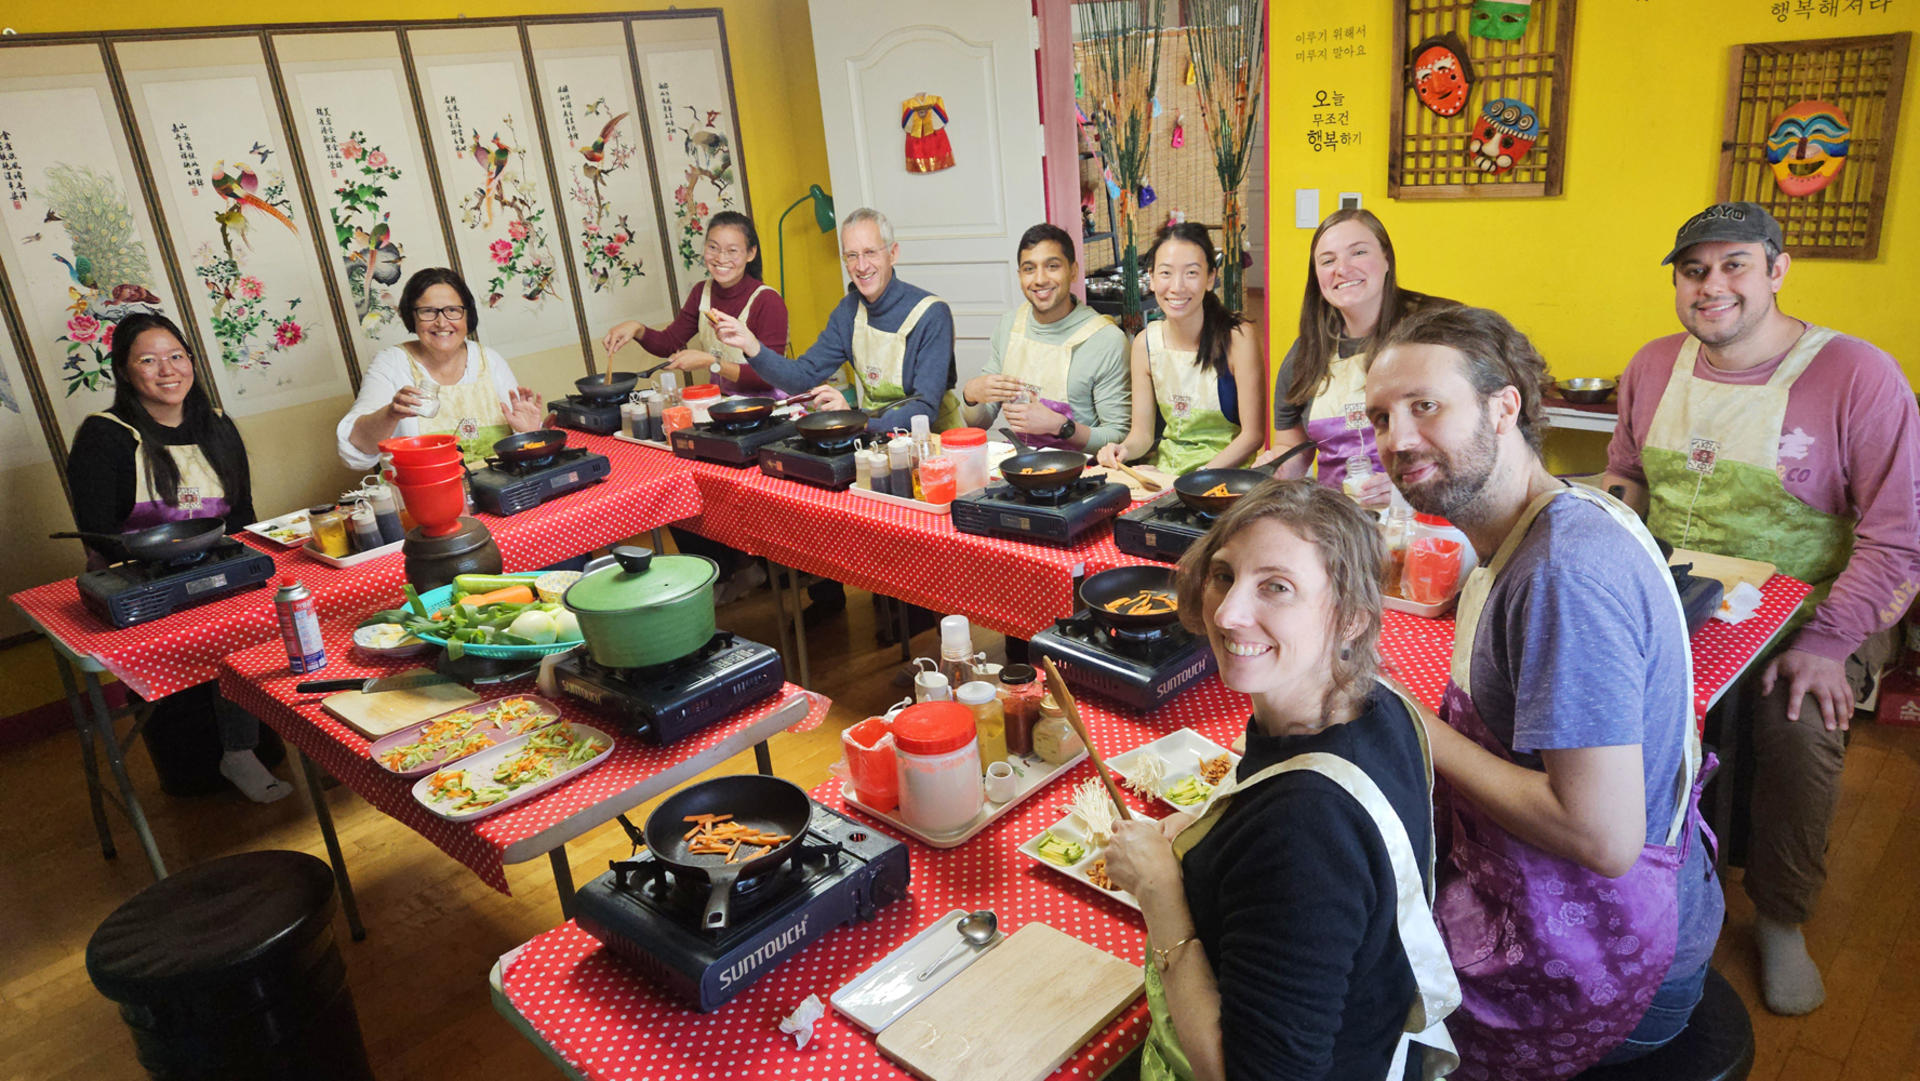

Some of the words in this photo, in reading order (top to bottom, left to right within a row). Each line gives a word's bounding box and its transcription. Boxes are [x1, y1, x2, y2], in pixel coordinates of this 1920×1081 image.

[1295, 29, 1327, 44] 이루기
[1333, 24, 1366, 40] 위해서
[1333, 44, 1367, 59] 말아요
[1312, 90, 1345, 108] 오늘
[1312, 110, 1349, 127] 무조건
[1307, 129, 1362, 152] 행복하기
[1157, 658, 1206, 699] SUNTOUCH
[719, 920, 807, 990] SUNTOUCH
